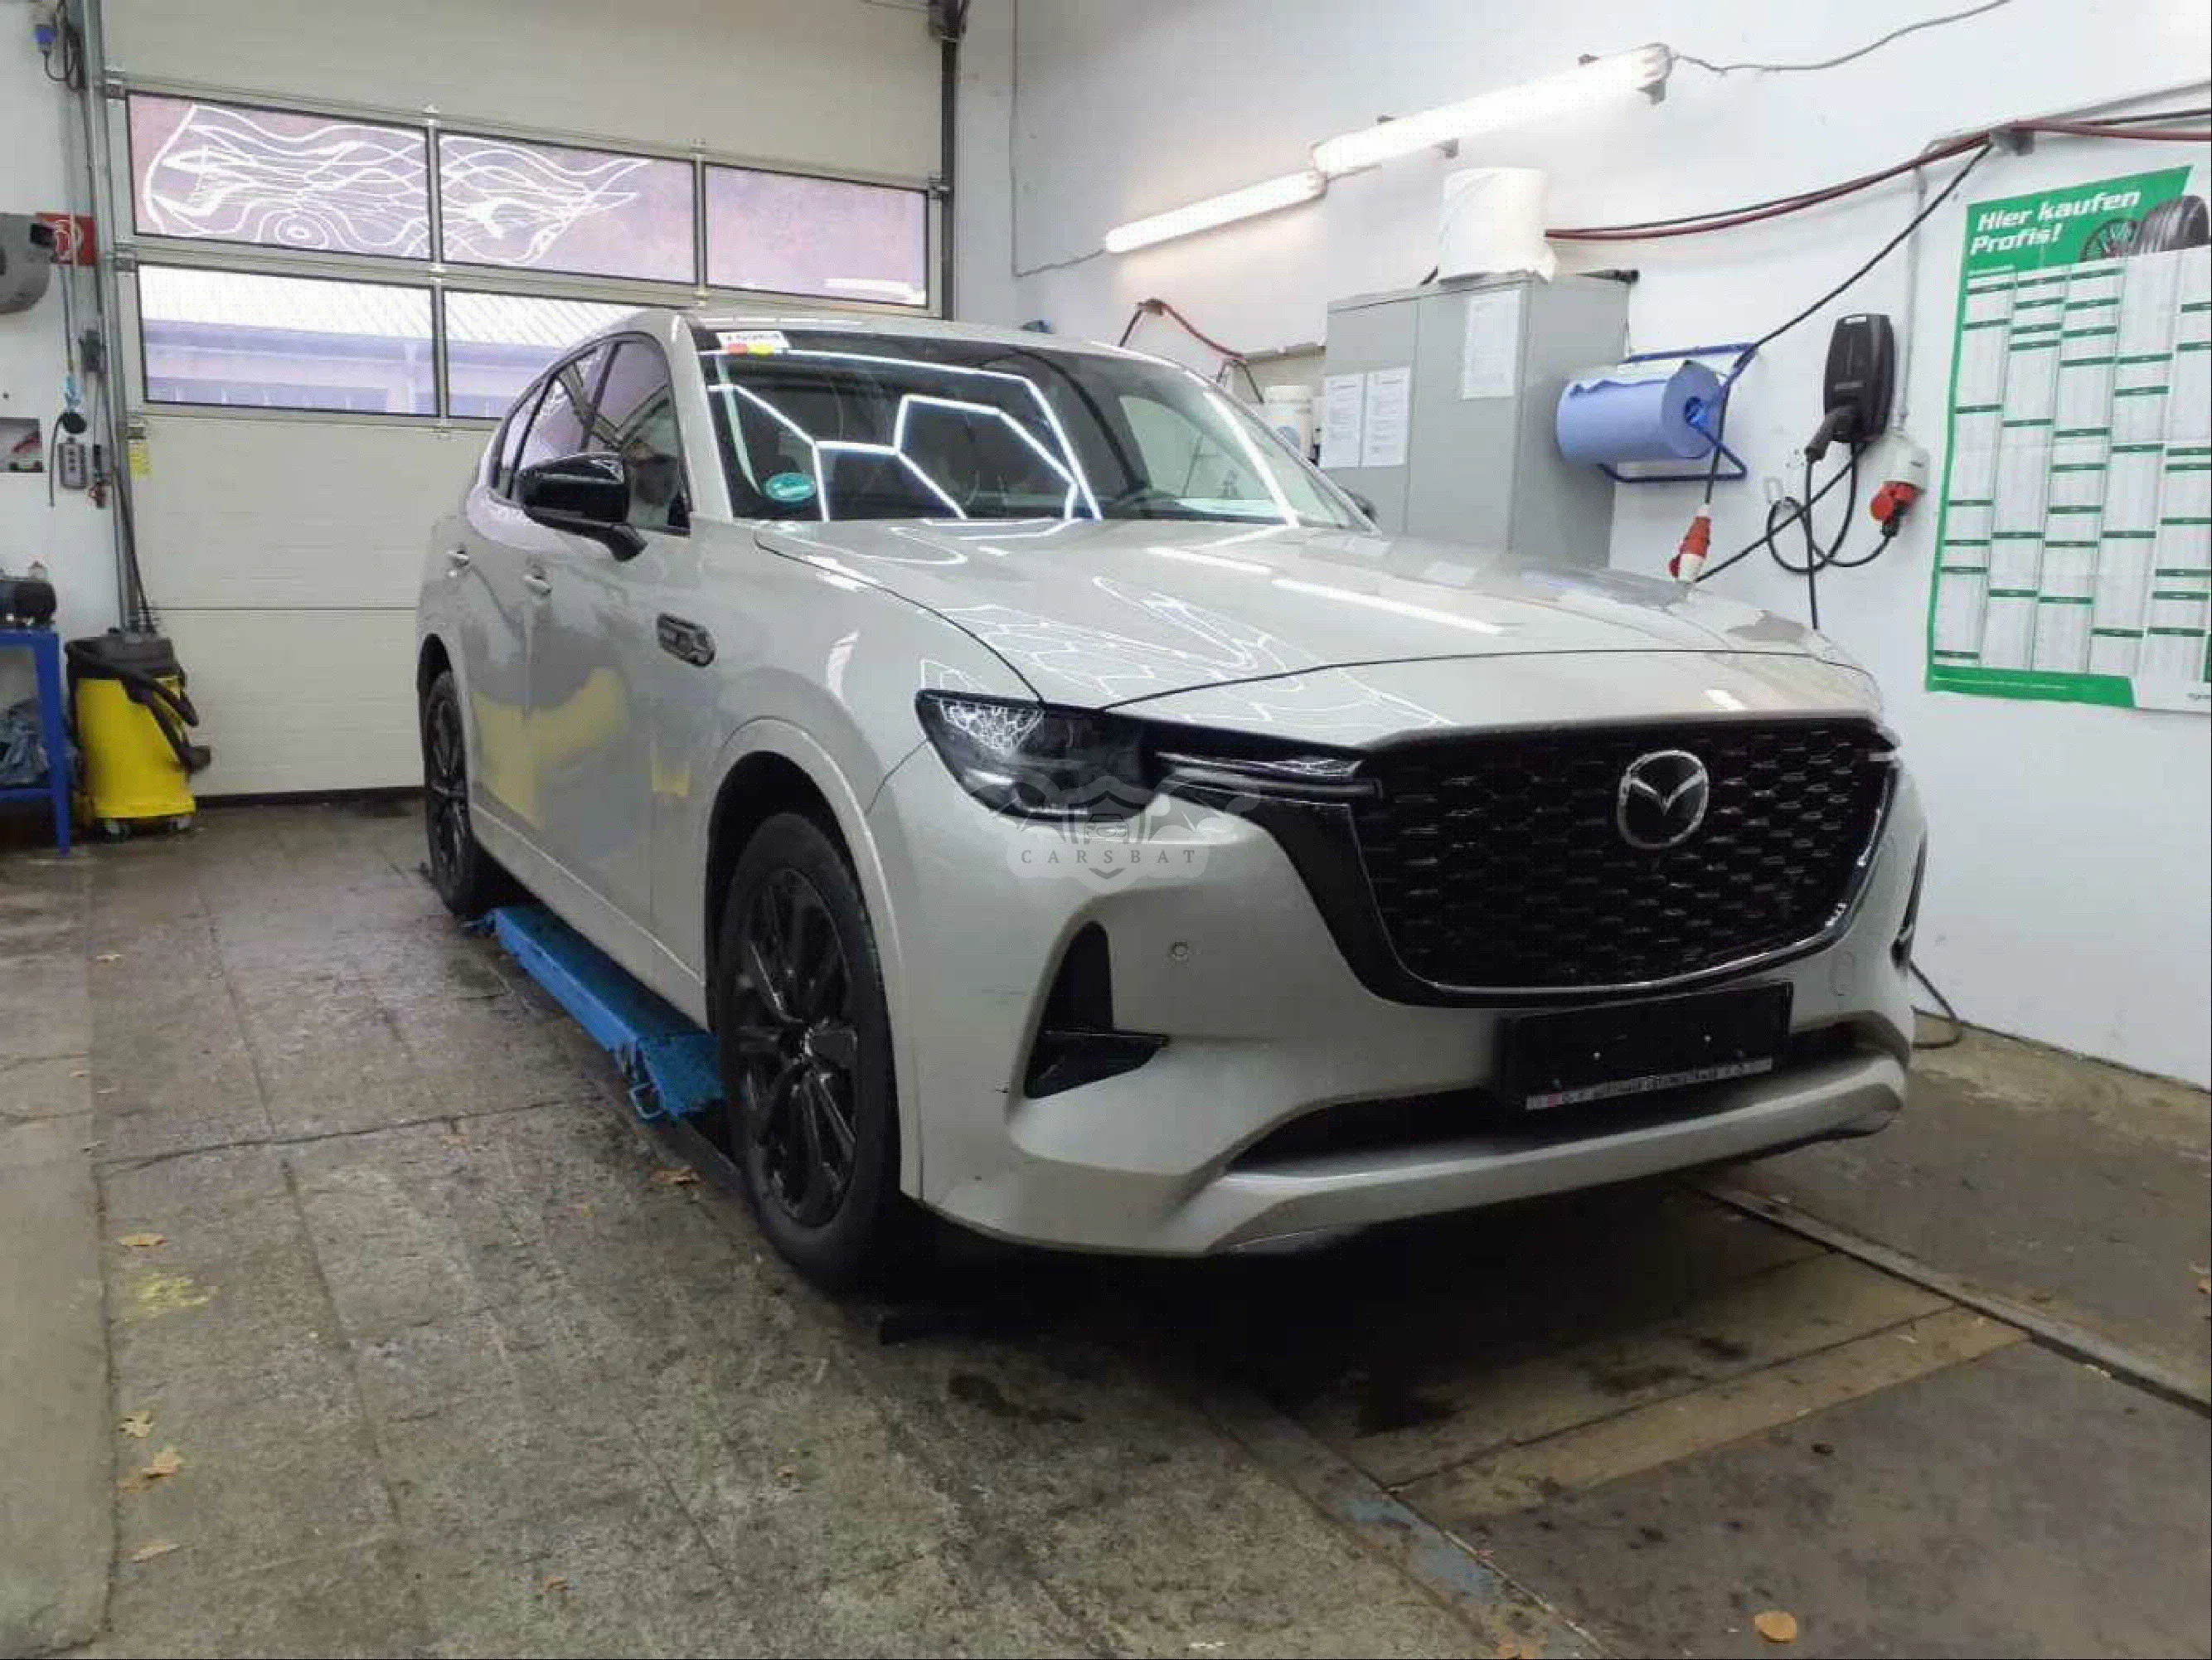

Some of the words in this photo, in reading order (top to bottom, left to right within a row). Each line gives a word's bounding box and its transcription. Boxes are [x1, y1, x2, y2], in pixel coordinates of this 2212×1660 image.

[1977, 209, 2033, 232] Hier
[2038, 191, 2142, 222] kaufen
[1969, 222, 2064, 255] Profis!
